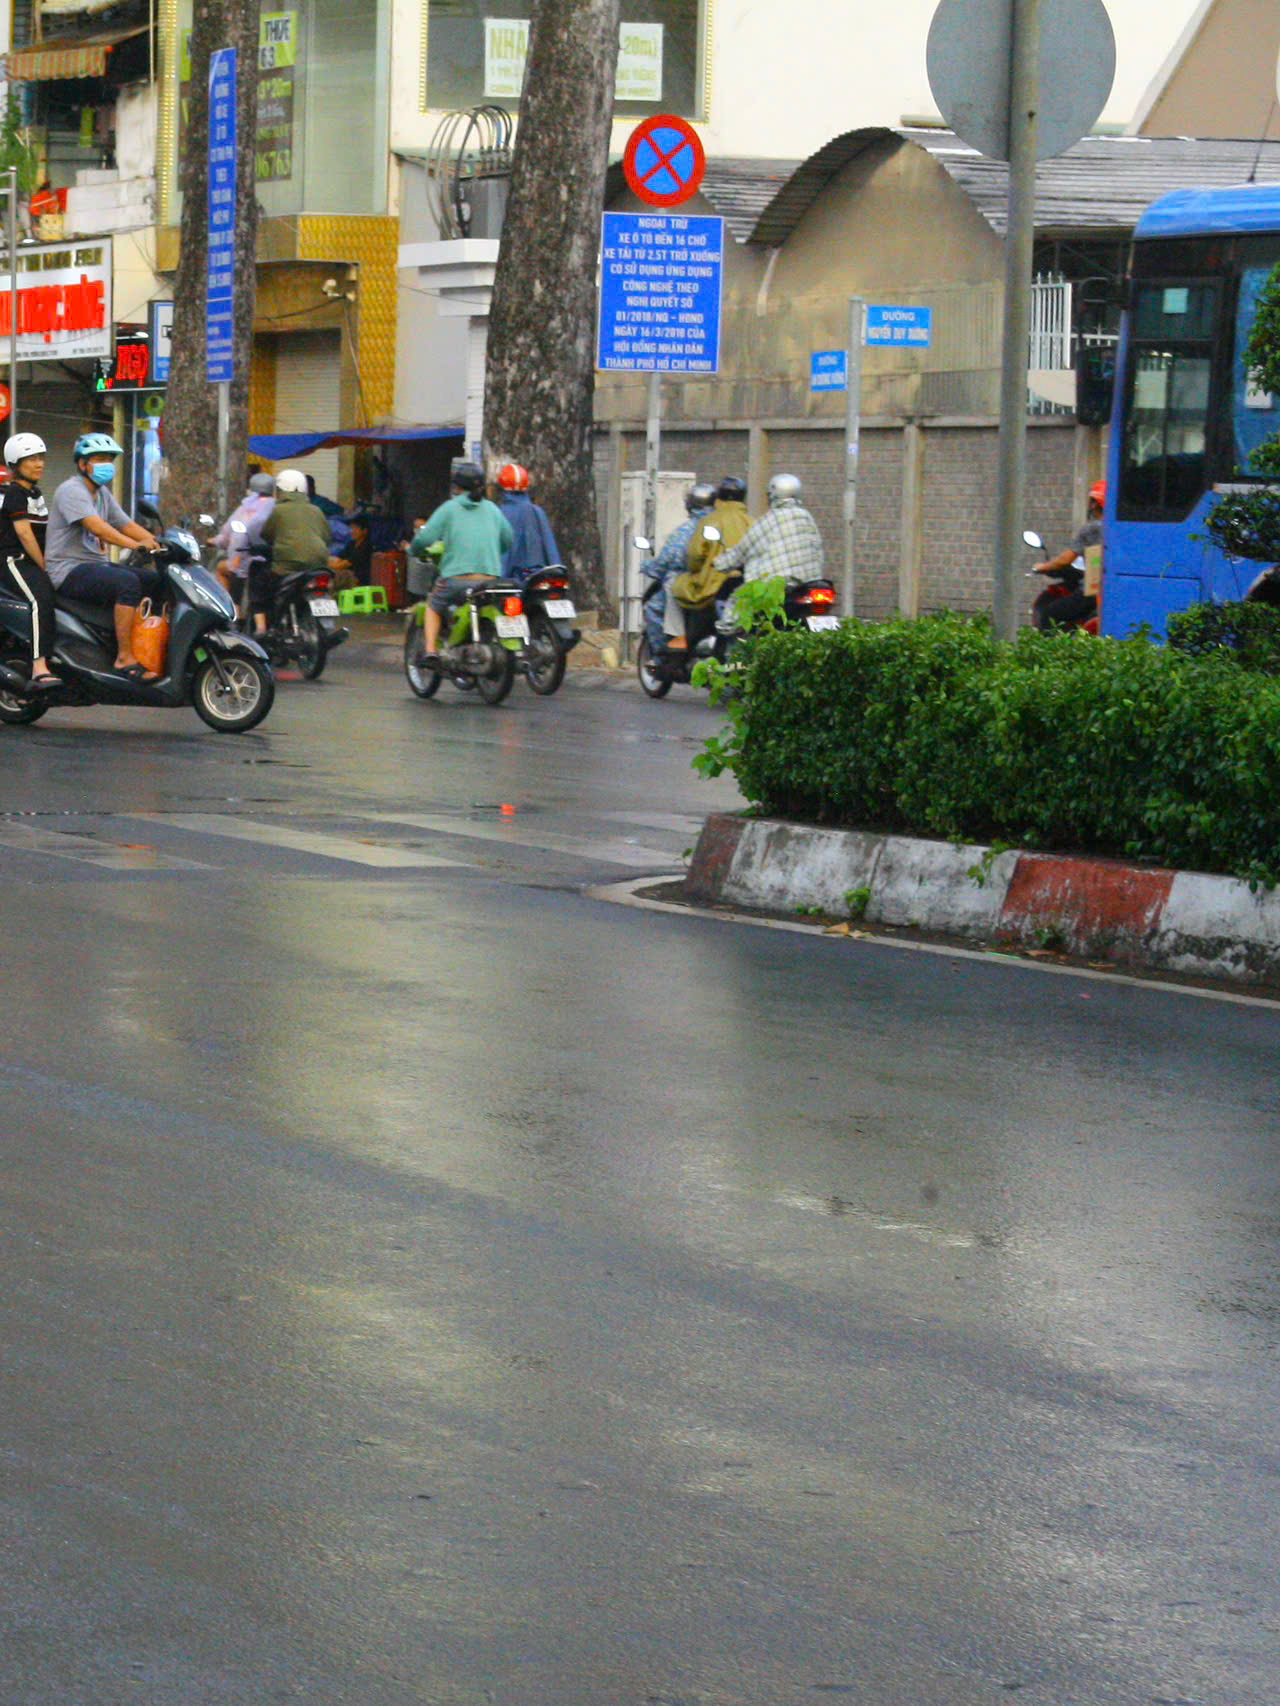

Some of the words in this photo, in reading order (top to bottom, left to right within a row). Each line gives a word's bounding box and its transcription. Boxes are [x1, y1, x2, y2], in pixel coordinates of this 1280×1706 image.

[638, 217, 666, 230] NGOẠI
[618, 232, 631, 244] XE
[641, 232, 653, 245] TÔ
[676, 233, 685, 245] 16
[604, 247, 616, 259] XE
[647, 249, 666, 261] 2.5T
[623, 280, 648, 291] CÔNG
[676, 281, 700, 293] THEO
[882, 310, 916, 321] ĐƯỜNG
[688, 359, 713, 371] MINH
